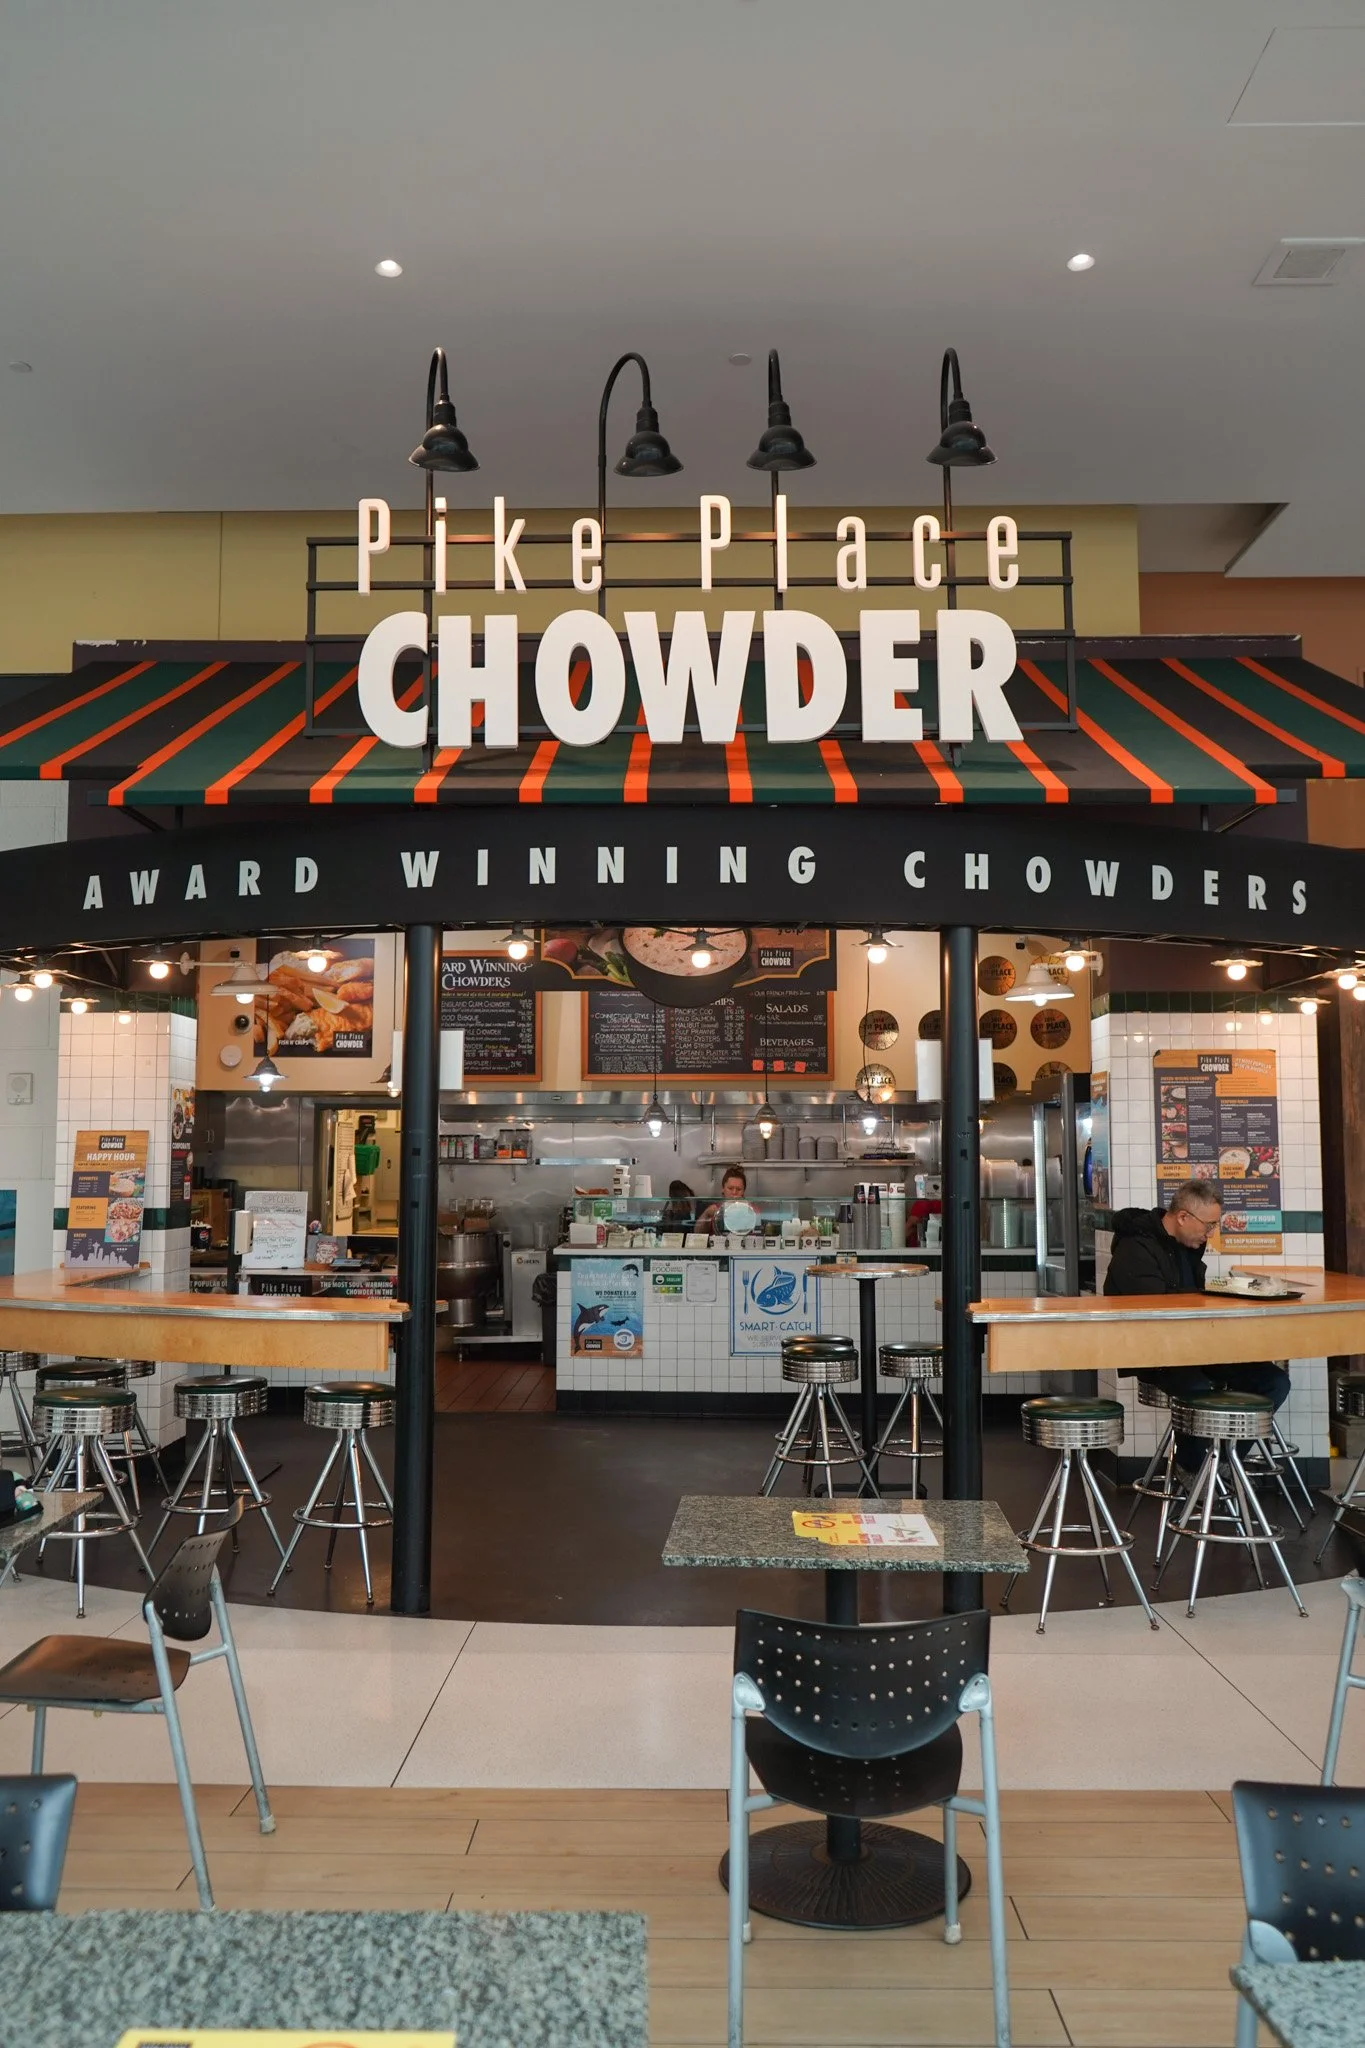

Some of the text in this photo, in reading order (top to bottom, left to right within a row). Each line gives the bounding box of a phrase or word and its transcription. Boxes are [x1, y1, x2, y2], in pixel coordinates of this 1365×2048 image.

[358, 494, 1020, 595] Pike Place
[357, 609, 1024, 749] CHOWDER
[83, 846, 1307, 914] AWARD WINNING CHOWDERS
[761, 957, 792, 966] CHOWDER
[468, 959, 533, 975] WINNING
[1048, 967, 1065, 975] LACE
[991, 968, 1011, 977] PLACE
[441, 973, 511, 991] CHOWDERS
[468, 1000, 483, 1008] CLAM
[485, 1000, 511, 1008] CHOWDER
[765, 1003, 809, 1013] SALADS
[874, 1023, 896, 1031] PLACE
[992, 1023, 1014, 1031] PLACE
[335, 1041, 364, 1049] CHOWDER
[759, 1037, 814, 1047] BEVERAGES
[1201, 1064, 1230, 1072] CHOWDER
[871, 1076, 892, 1084] PLACE
[86, 1152, 136, 1161] HAPPY HOUR
[261, 1283, 302, 1293] Pike Place
